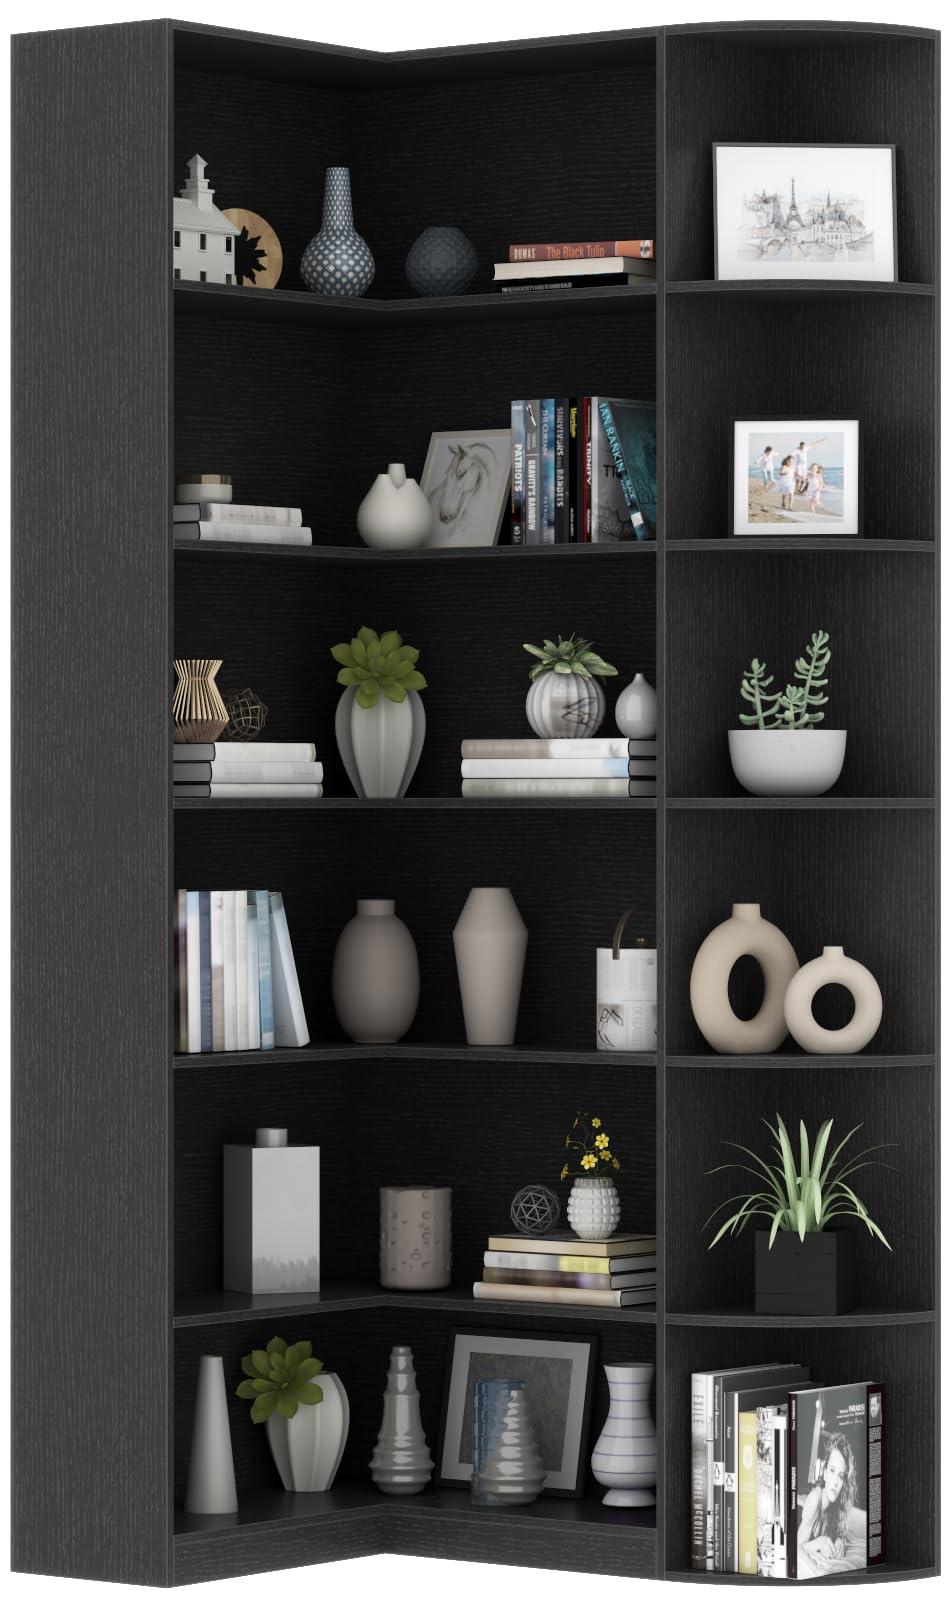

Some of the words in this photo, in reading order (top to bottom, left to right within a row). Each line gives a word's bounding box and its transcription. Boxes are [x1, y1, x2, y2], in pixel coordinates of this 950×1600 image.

[513, 247, 536, 260] DUMAS
[546, 246, 561, 259] The
[563, 245, 585, 259] Black
[599, 402, 611, 426] IAN
[605, 426, 626, 474] RANKIN
[514, 443, 523, 492] PATRIOTS
[527, 459, 536, 497] GRAVITY'S
[527, 497, 536, 531] RAINBOW
